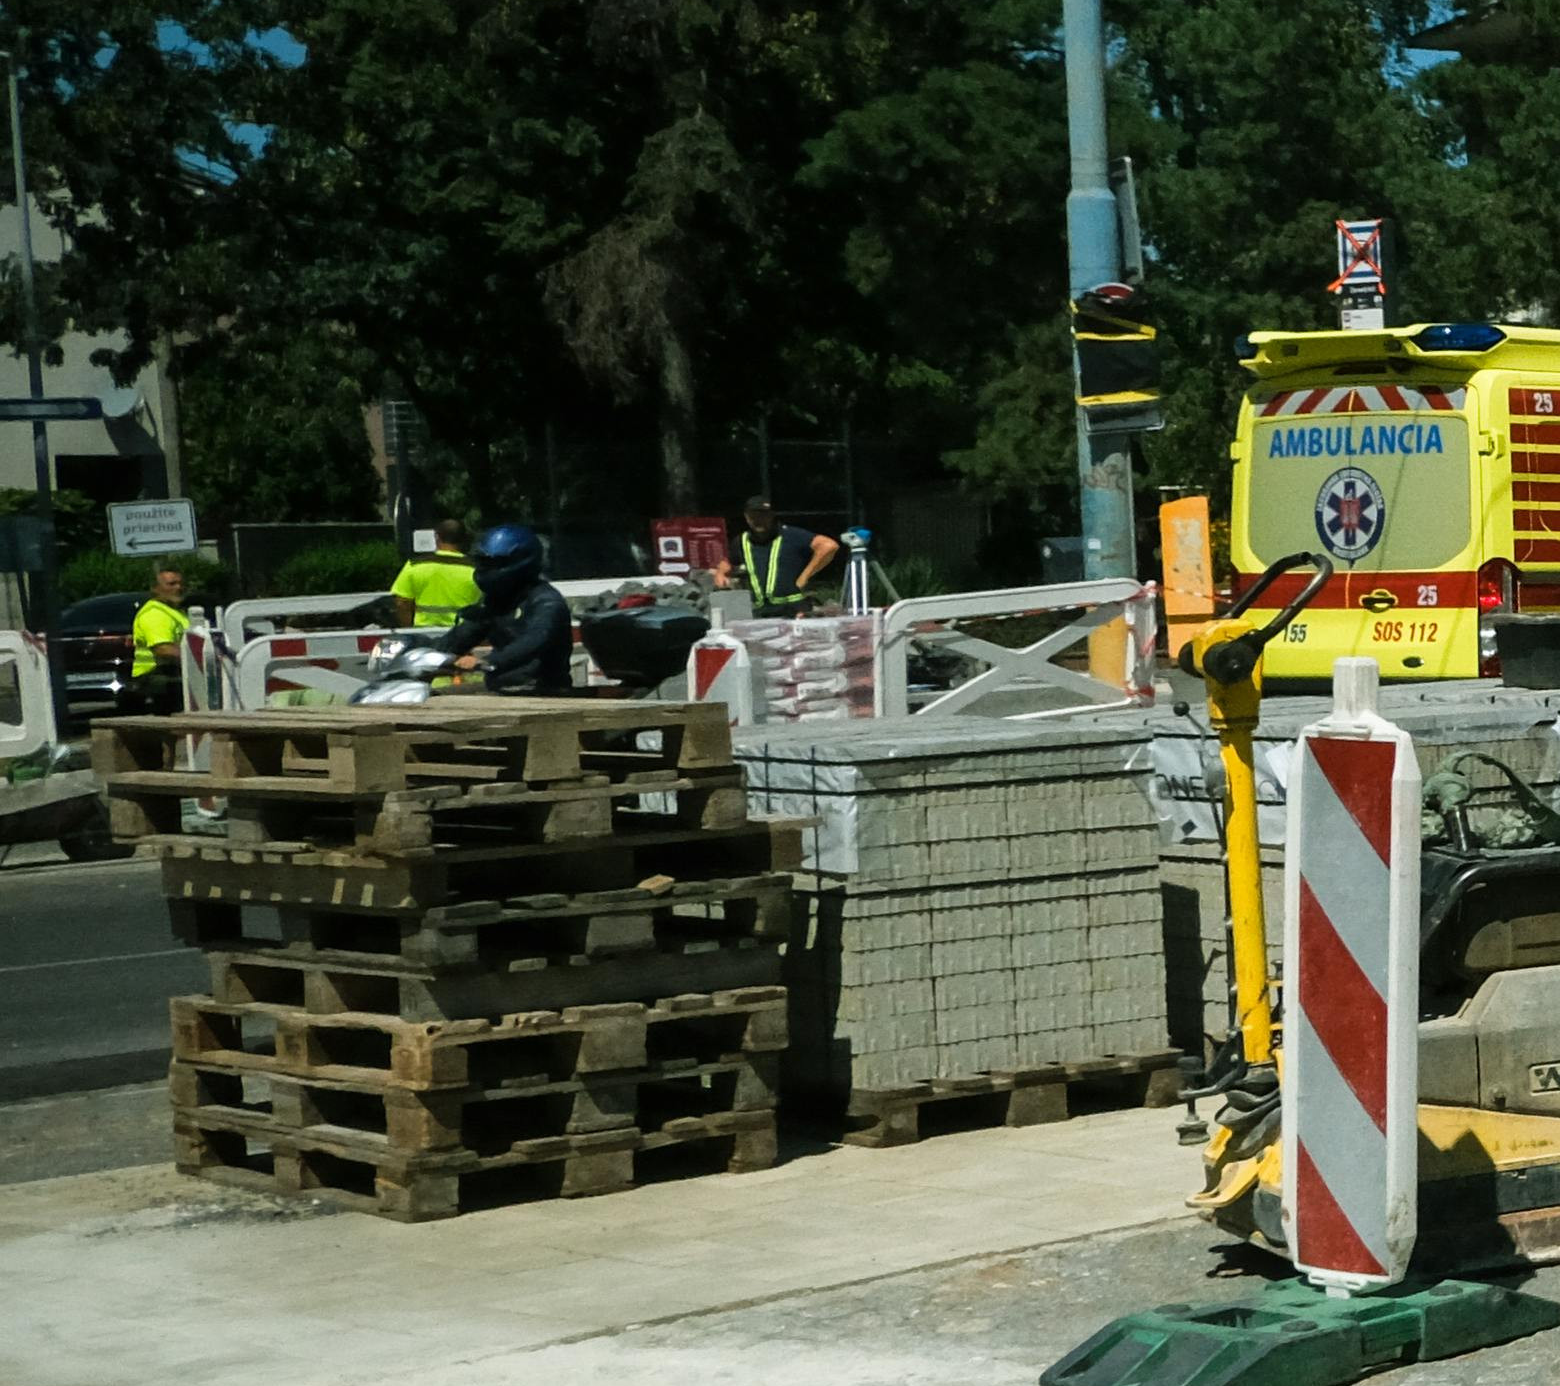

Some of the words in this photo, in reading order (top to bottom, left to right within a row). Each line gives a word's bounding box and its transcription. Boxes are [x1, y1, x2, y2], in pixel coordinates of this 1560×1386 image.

[1533, 392, 1554, 413] 25
[1268, 424, 1444, 459] AMBULANCIA
[1417, 584, 1438, 606] 25
[1283, 623, 1307, 643] 155
[1372, 621, 1403, 643] SOS
[1409, 622, 1438, 643] 112
